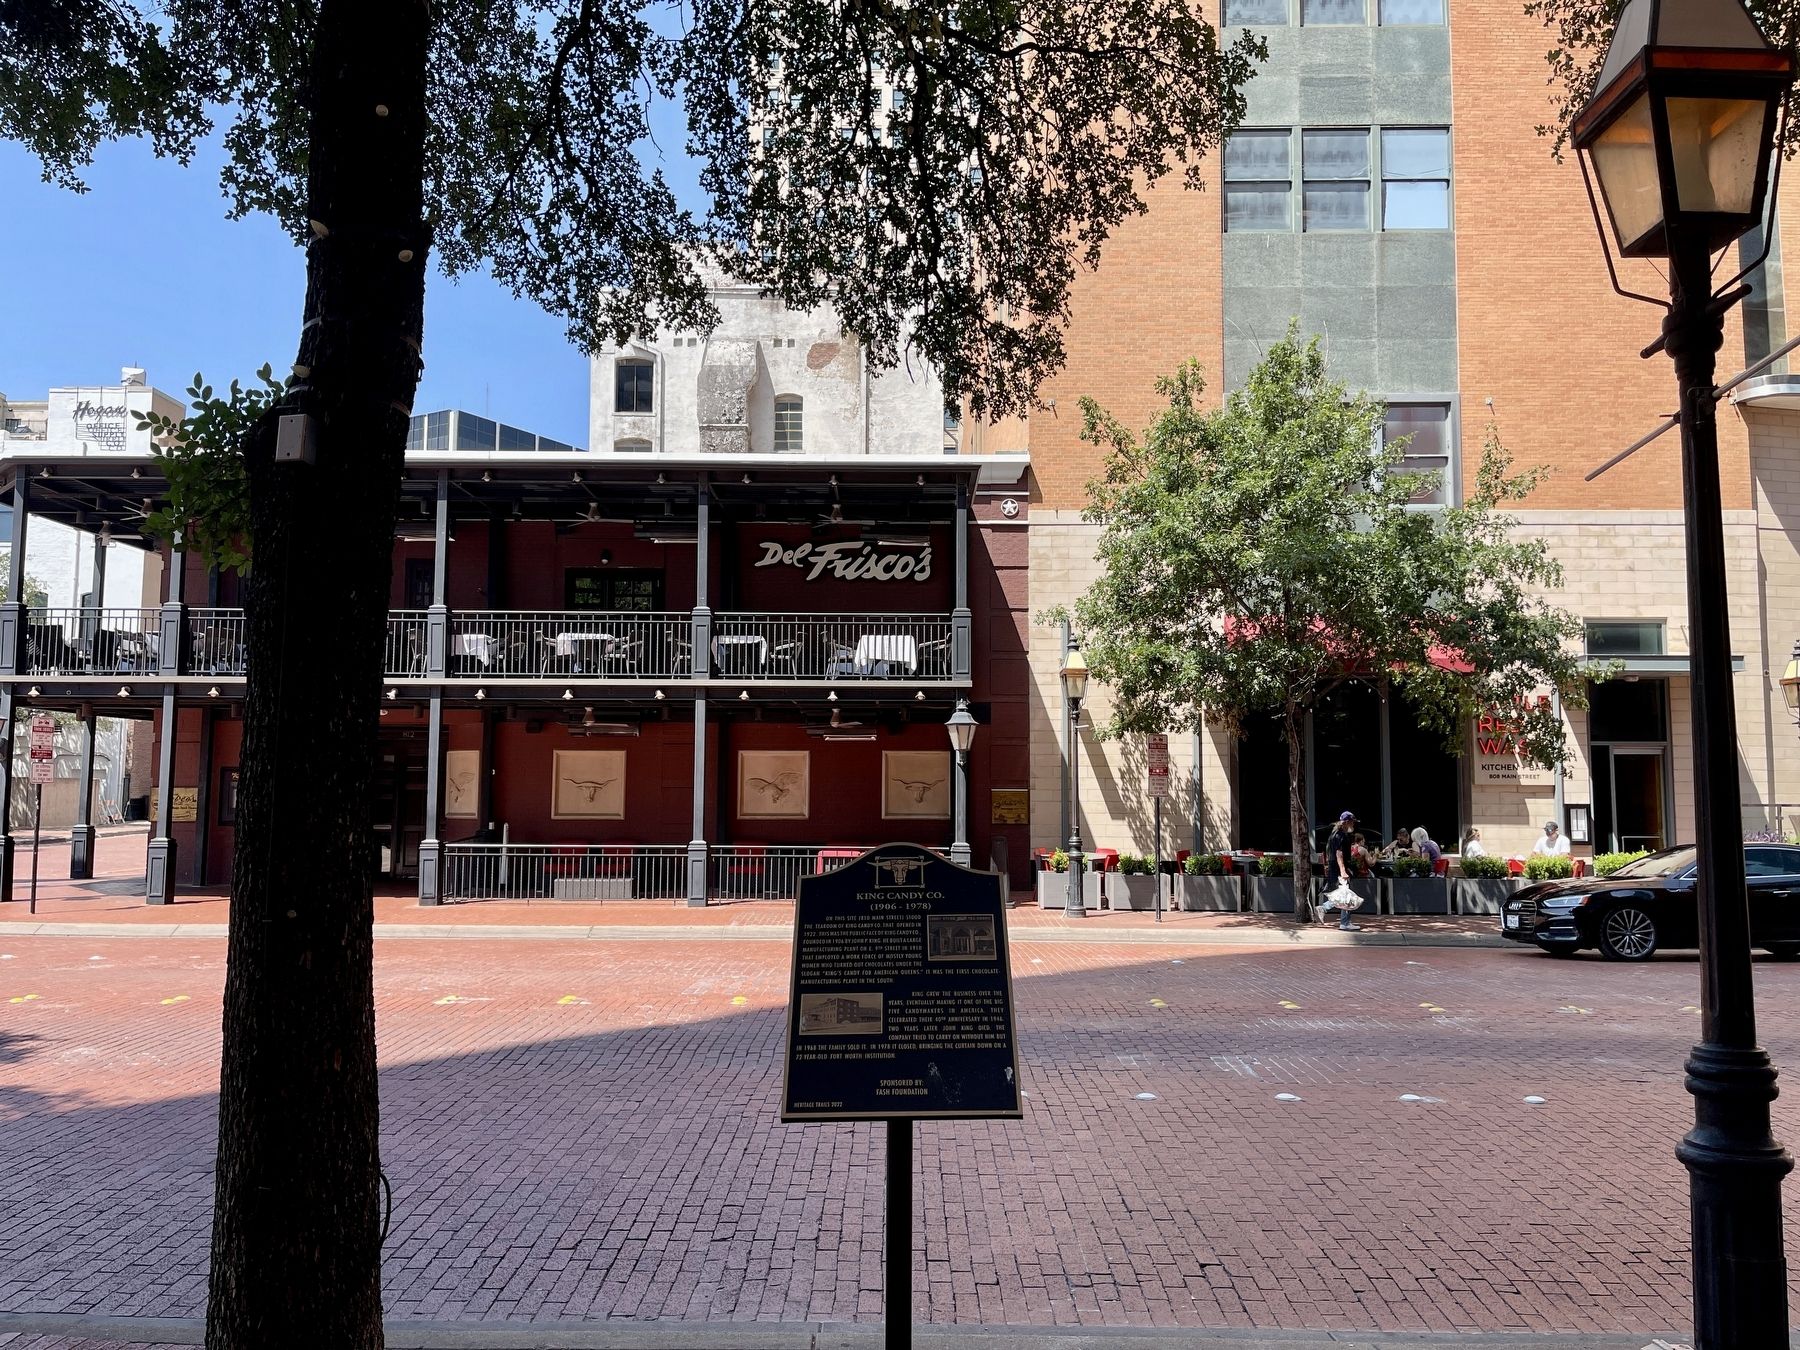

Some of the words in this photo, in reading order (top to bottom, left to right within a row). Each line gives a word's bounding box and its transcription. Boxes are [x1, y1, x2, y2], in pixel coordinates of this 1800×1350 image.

[86, 422, 120, 430] OFFICE
[754, 542, 813, 568] Del
[806, 541, 932, 582] Frisco's
[1481, 763, 1519, 771] KITCHEN
[857, 892, 885, 900] KING
[887, 892, 924, 900] CANDY
[926, 891, 945, 899] CO.
[906, 902, 931, 910] 1978)
